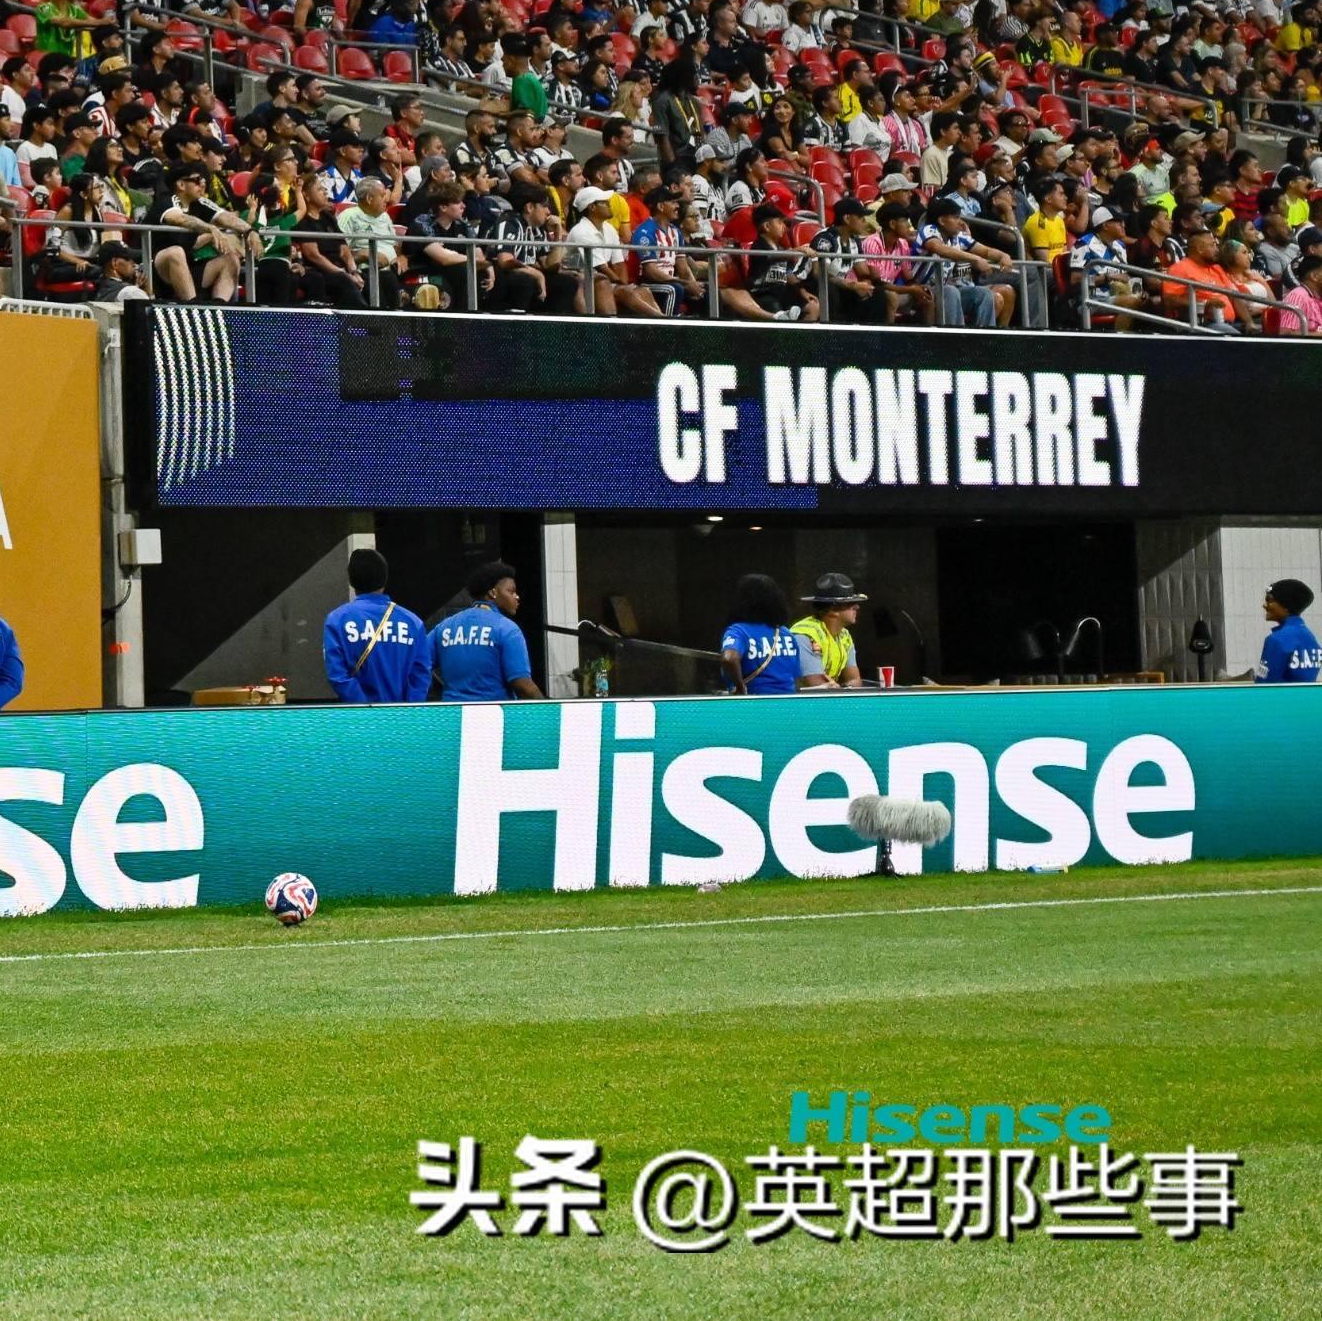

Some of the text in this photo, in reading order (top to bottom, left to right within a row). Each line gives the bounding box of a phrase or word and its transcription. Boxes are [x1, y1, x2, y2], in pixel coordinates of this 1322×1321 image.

[658, 361, 1146, 487] CF MONTERREY
[453, 701, 1197, 896] Hisense
